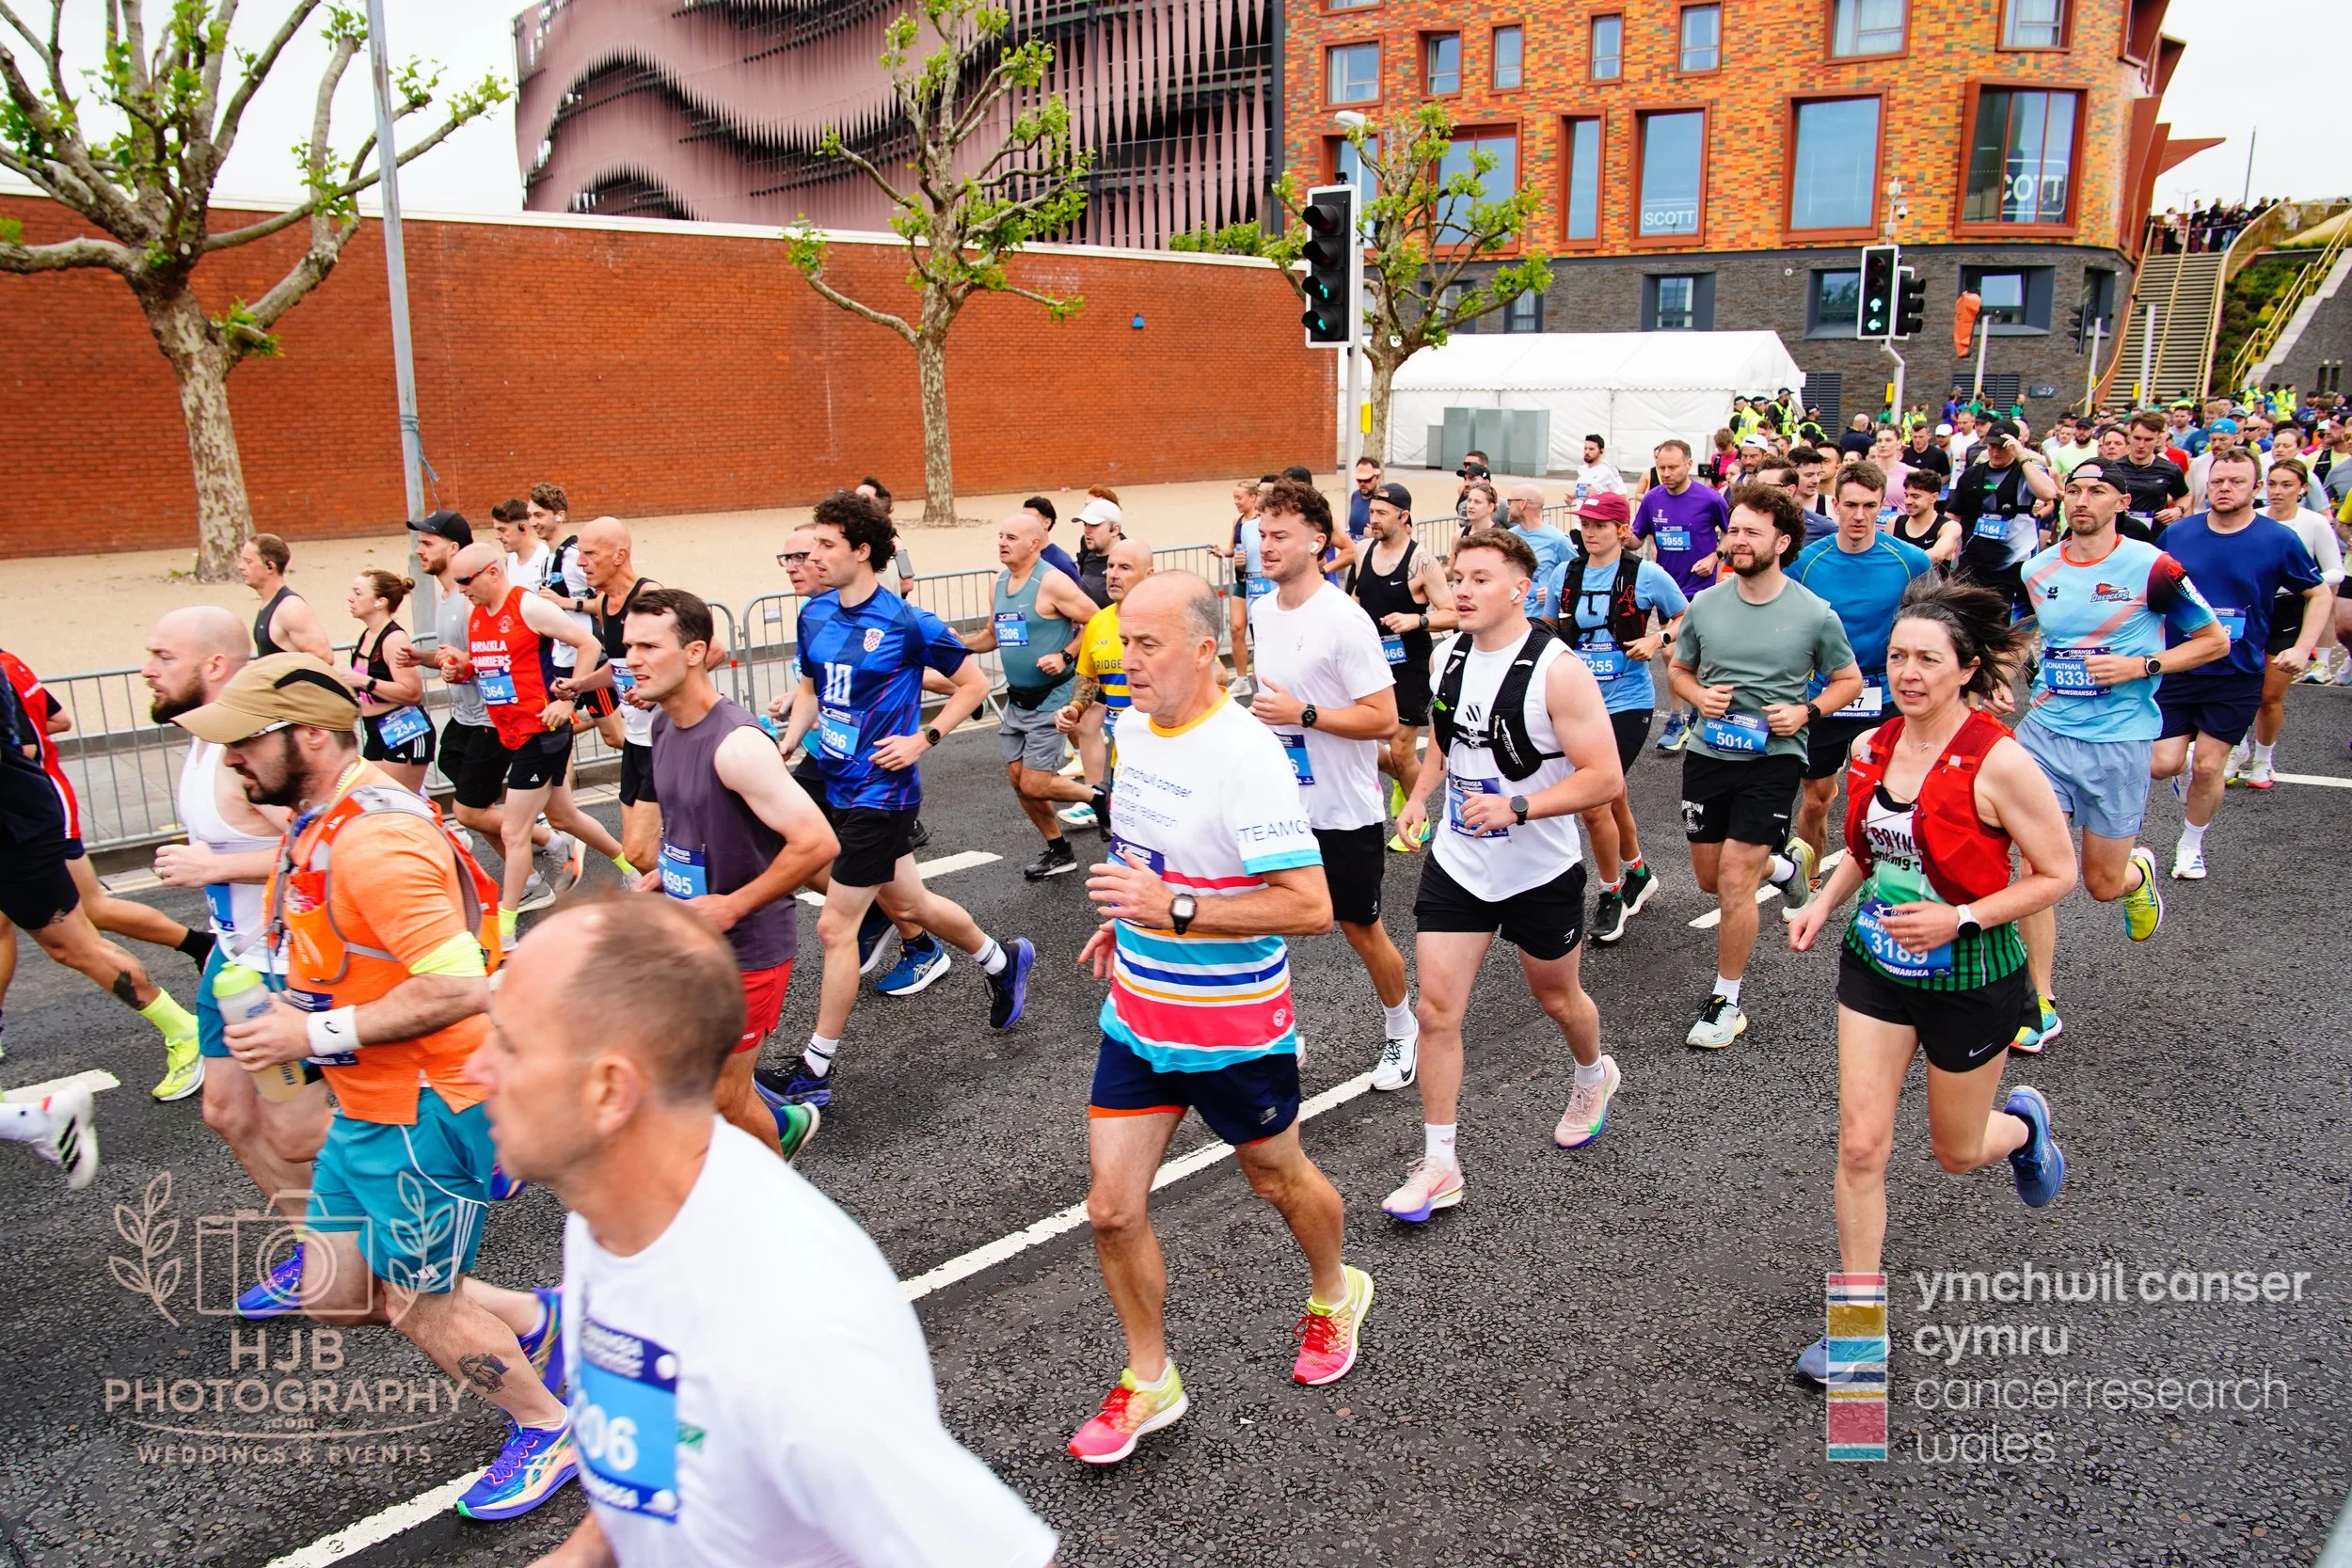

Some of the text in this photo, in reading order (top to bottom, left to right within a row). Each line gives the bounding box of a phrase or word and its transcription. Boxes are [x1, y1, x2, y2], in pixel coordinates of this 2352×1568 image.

[1644, 210, 1695, 227] SCOTT
[1661, 537, 1684, 546] 3955
[470, 641, 508, 652] BRACKLA
[1094, 658, 1122, 671] RIDGE
[823, 661, 852, 707] 10
[2055, 670, 2096, 687] 8338
[1706, 721, 1724, 732] IOAN
[1735, 714, 1758, 724] SWANSEA
[393, 720, 418, 739] 234
[1716, 731, 1754, 751] 5014
[574, 1389, 639, 1472] 06
